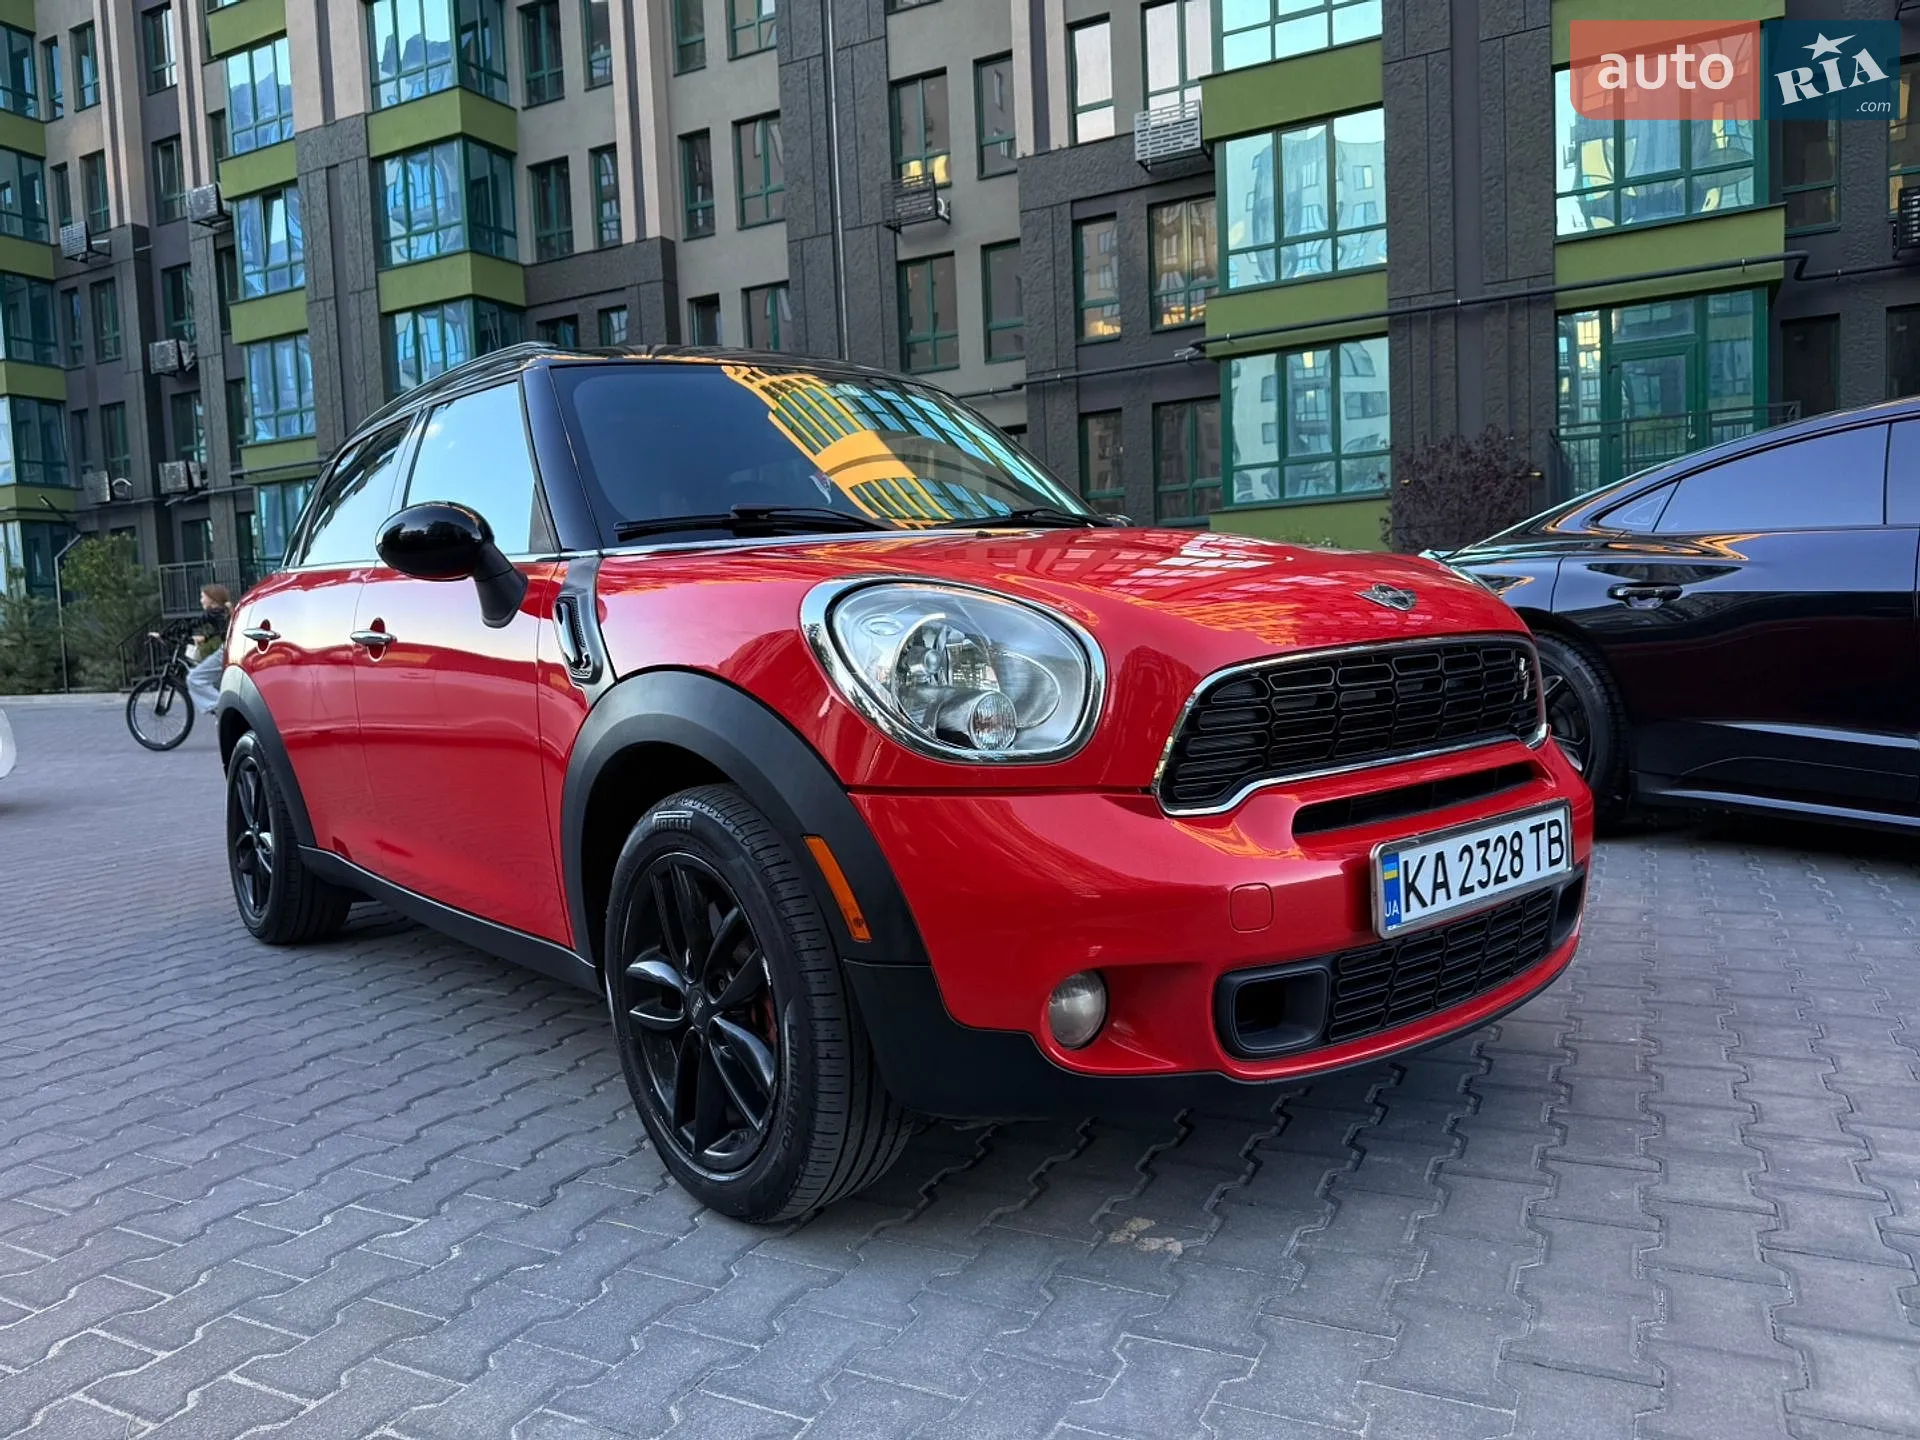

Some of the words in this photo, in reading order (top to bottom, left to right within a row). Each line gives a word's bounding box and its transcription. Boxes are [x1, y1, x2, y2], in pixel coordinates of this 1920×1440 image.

[1402, 851, 1452, 913] KA
[1458, 831, 1524, 897] 2328
[1529, 818, 1565, 872] TB
[1384, 901, 1400, 918] UA
